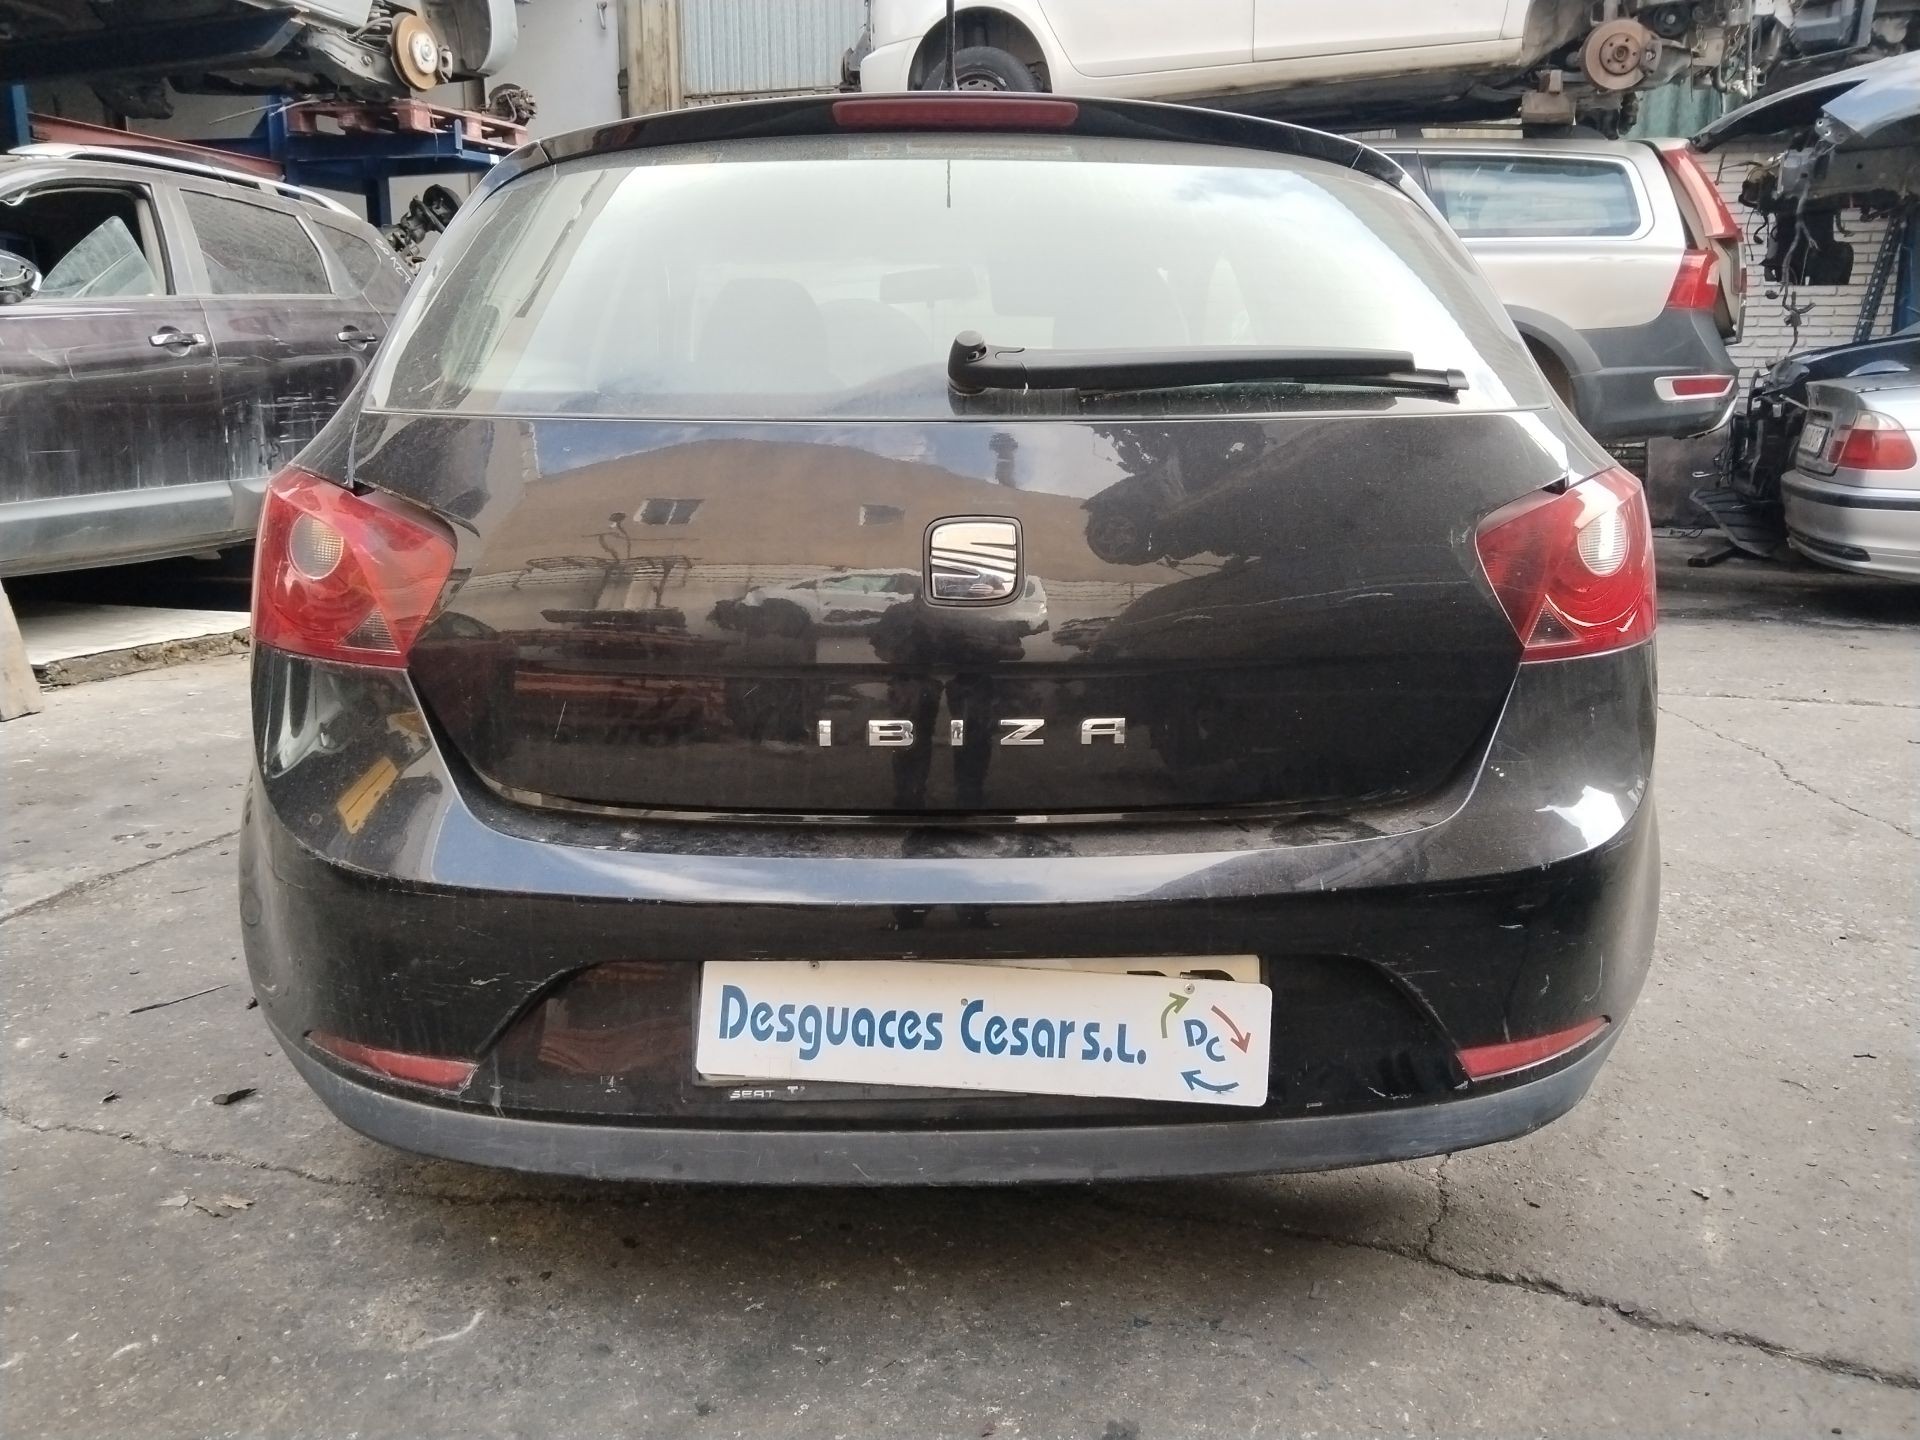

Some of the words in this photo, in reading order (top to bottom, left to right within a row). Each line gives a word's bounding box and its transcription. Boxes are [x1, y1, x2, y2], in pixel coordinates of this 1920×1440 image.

[818, 717, 1126, 747] IBIZA
[718, 983, 944, 1061] Desguaces
[960, 999, 1075, 1059] Cesar
[729, 1089, 776, 1099] SEAT
